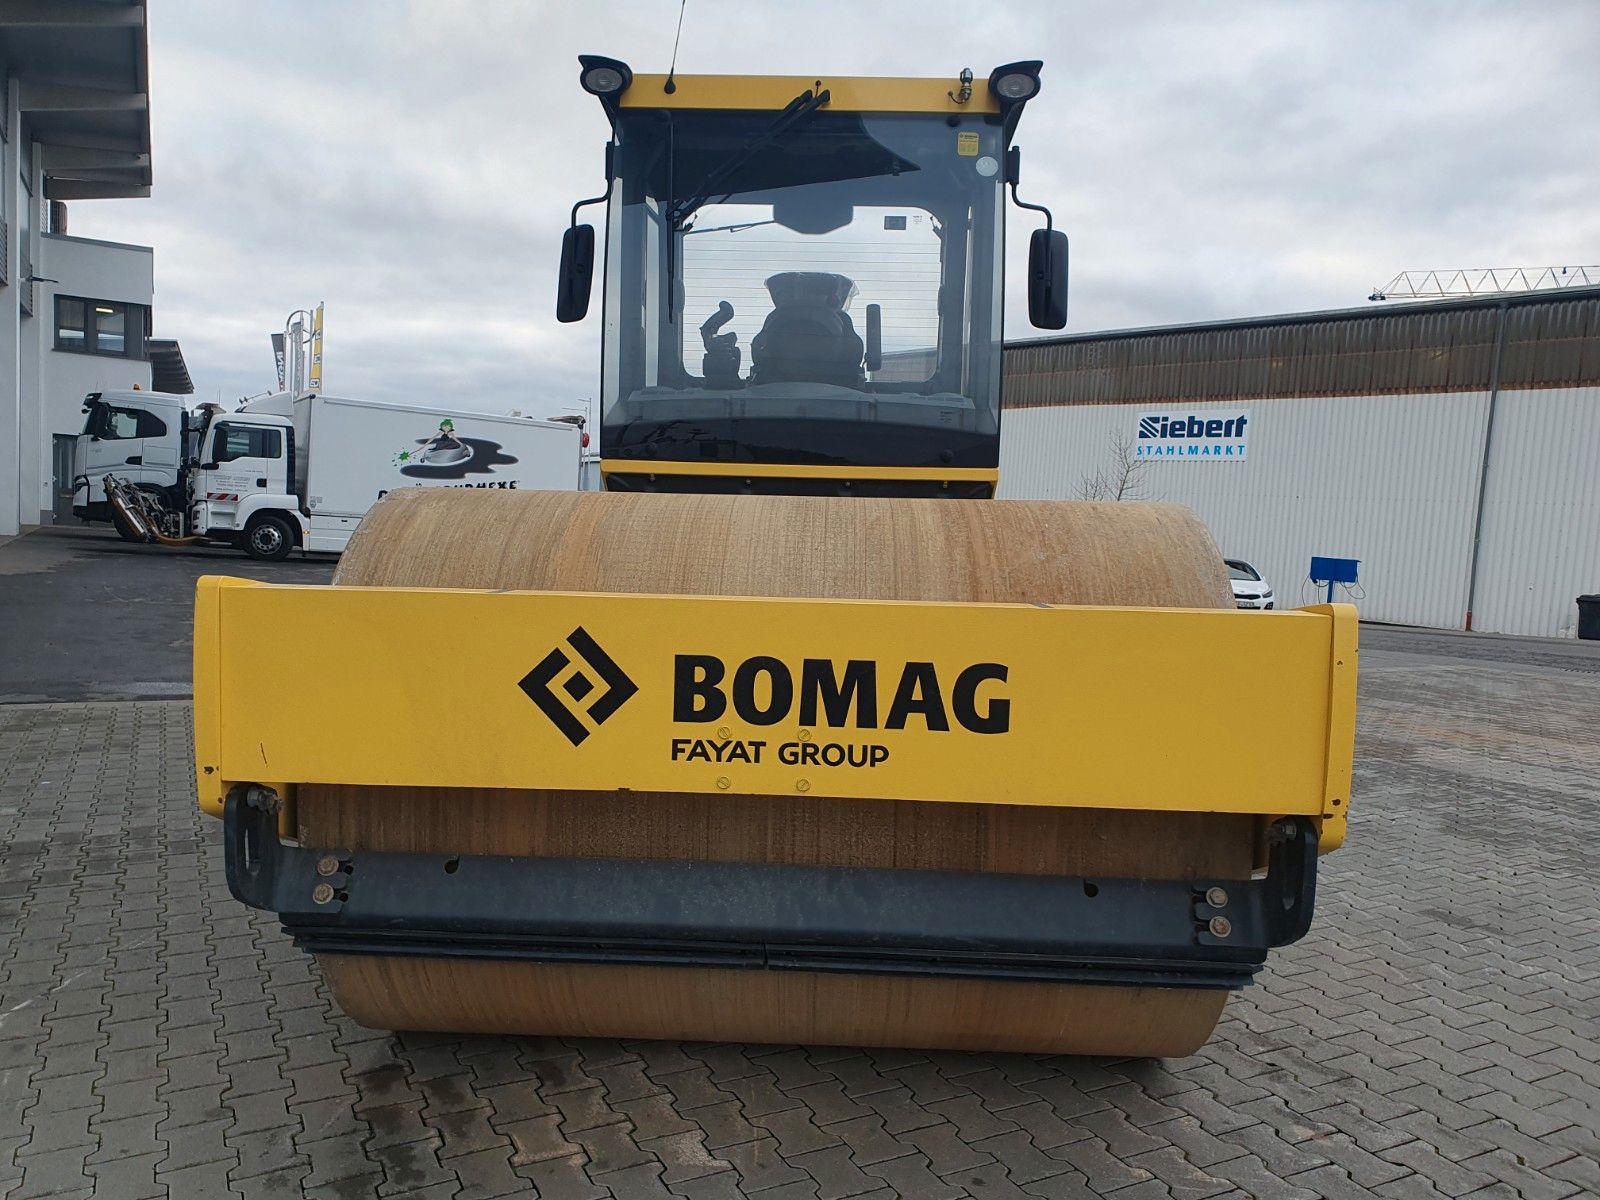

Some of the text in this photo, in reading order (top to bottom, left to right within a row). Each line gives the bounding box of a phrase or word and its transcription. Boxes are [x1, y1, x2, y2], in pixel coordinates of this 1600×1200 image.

[1138, 415, 1248, 439] Siebert
[1136, 445, 1245, 456] STAHLMARKT
[673, 654, 1011, 734] BOMAG
[671, 739, 890, 768] FAYAT GROUP
